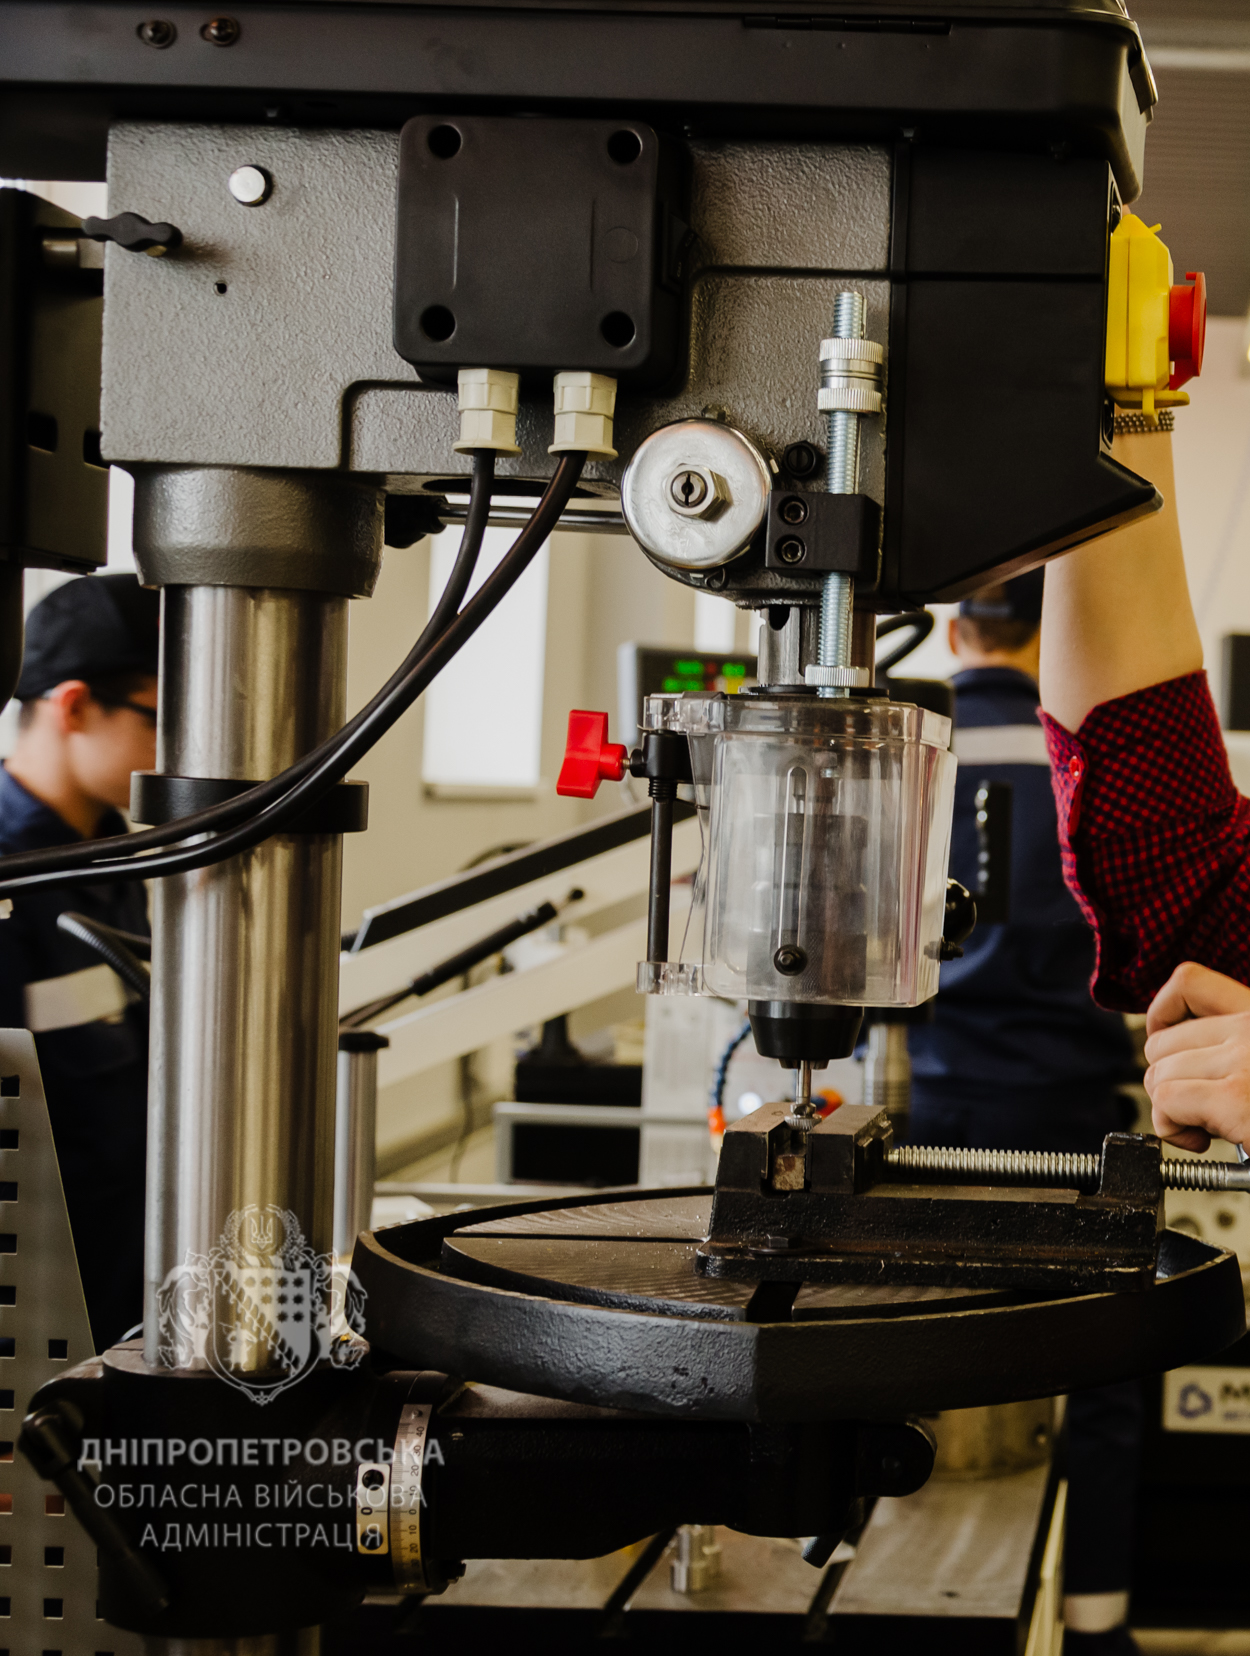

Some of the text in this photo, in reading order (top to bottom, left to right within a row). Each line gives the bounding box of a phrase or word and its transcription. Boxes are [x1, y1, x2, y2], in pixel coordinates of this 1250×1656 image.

[416, 1426, 425, 1438] 40
[410, 1465, 420, 1477] 20
[360, 1507, 373, 1516] 0
[408, 1508, 417, 1516] 0
[408, 1524, 417, 1536] 10
[409, 1543, 419, 1554] 20
